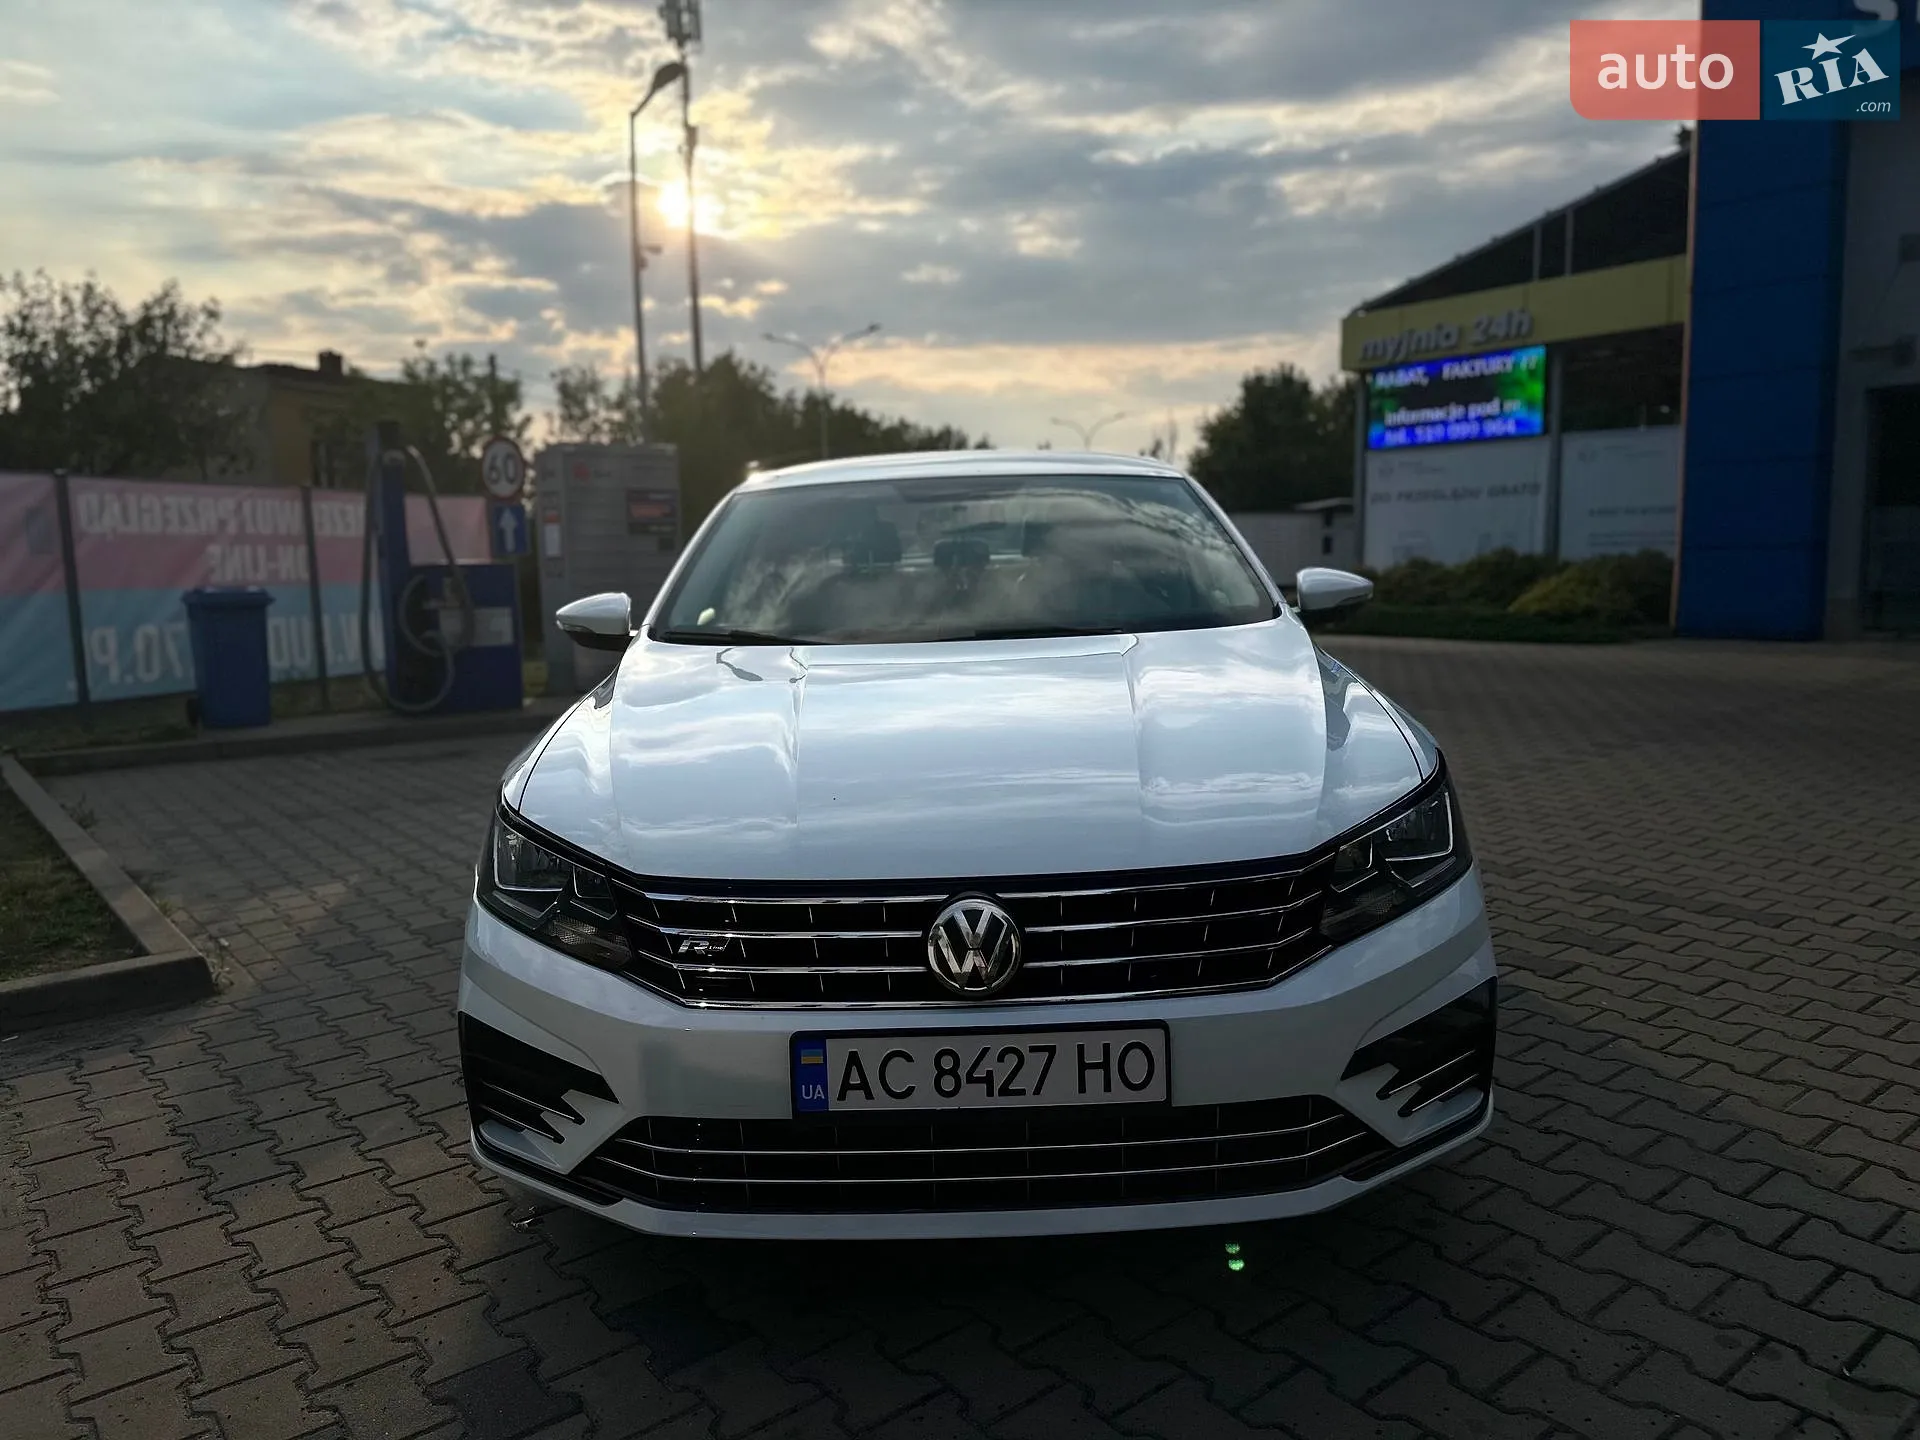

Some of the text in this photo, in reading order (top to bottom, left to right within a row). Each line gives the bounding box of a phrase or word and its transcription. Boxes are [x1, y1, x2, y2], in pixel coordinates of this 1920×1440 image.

[1361, 308, 1533, 361] myjnia 24h
[1442, 354, 1514, 382] FAKTURY
[1468, 397, 1501, 420] pod
[487, 452, 517, 486] 60
[802, 1041, 1156, 1102] UA AC 8427 HO
